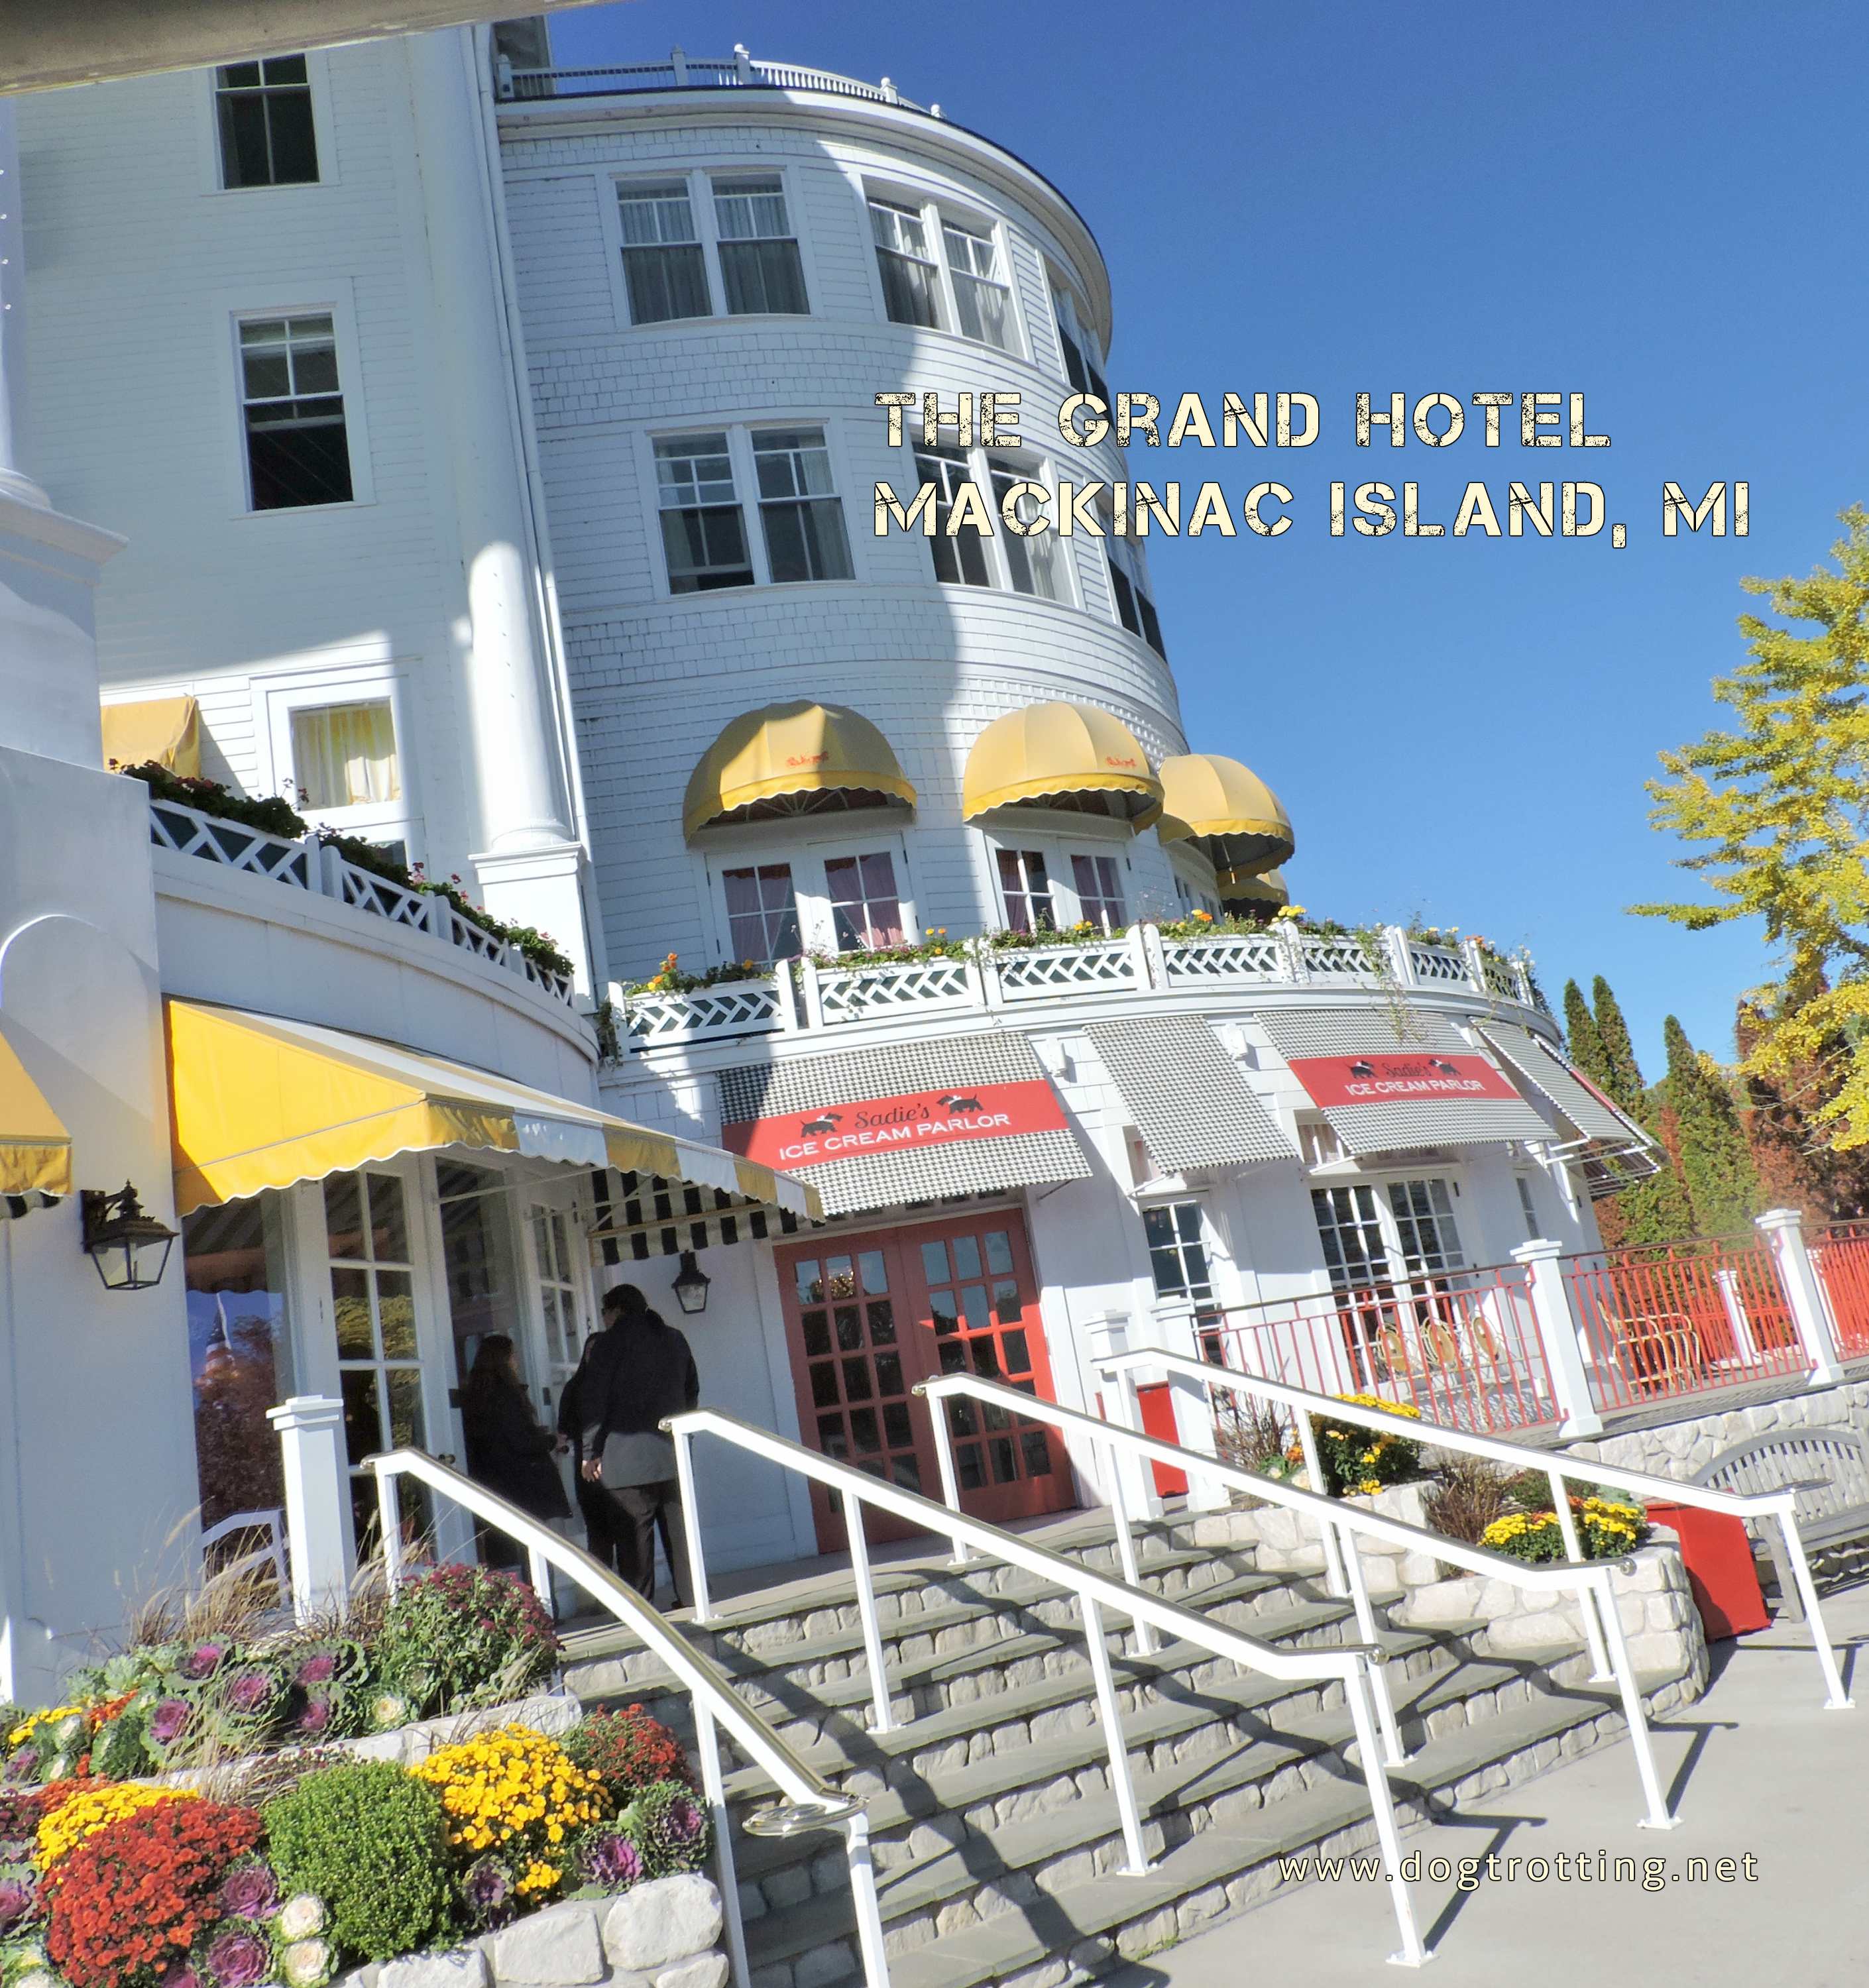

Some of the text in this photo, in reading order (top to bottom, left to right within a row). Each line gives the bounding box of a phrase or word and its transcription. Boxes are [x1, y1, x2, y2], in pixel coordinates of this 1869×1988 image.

[1383, 1063, 1432, 1077] Sadie's
[1345, 1079, 1486, 1095] ICE CREAM PARLOR
[854, 1103, 929, 1129] Sadie's
[779, 1113, 1011, 1160] ICE CREAM PARLOR
